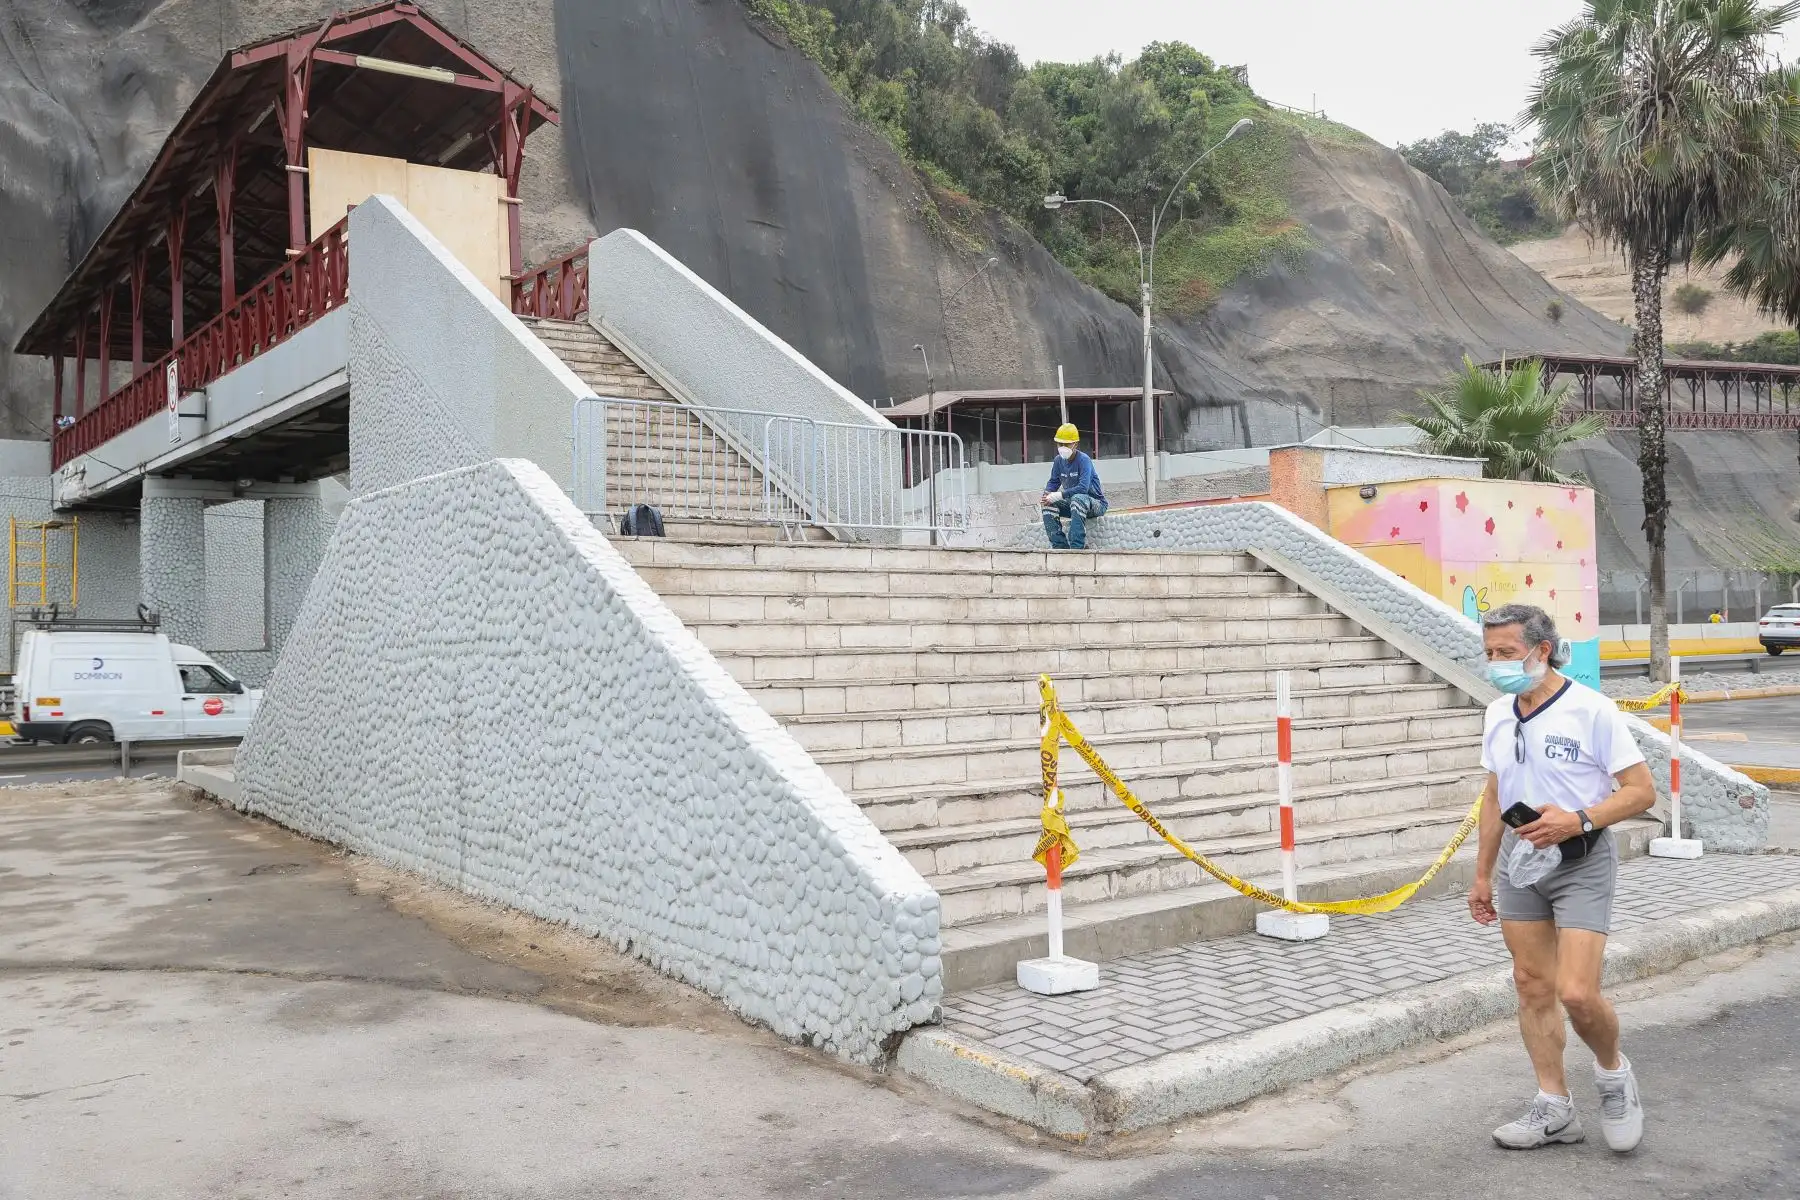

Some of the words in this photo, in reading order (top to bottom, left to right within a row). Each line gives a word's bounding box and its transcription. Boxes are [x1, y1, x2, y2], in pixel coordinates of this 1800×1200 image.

[74, 672, 122, 680] DOMINION
[1544, 744, 1579, 762] G-70
[1132, 804, 1168, 837] OBRAS
[1449, 816, 1476, 852] PELIGRO
